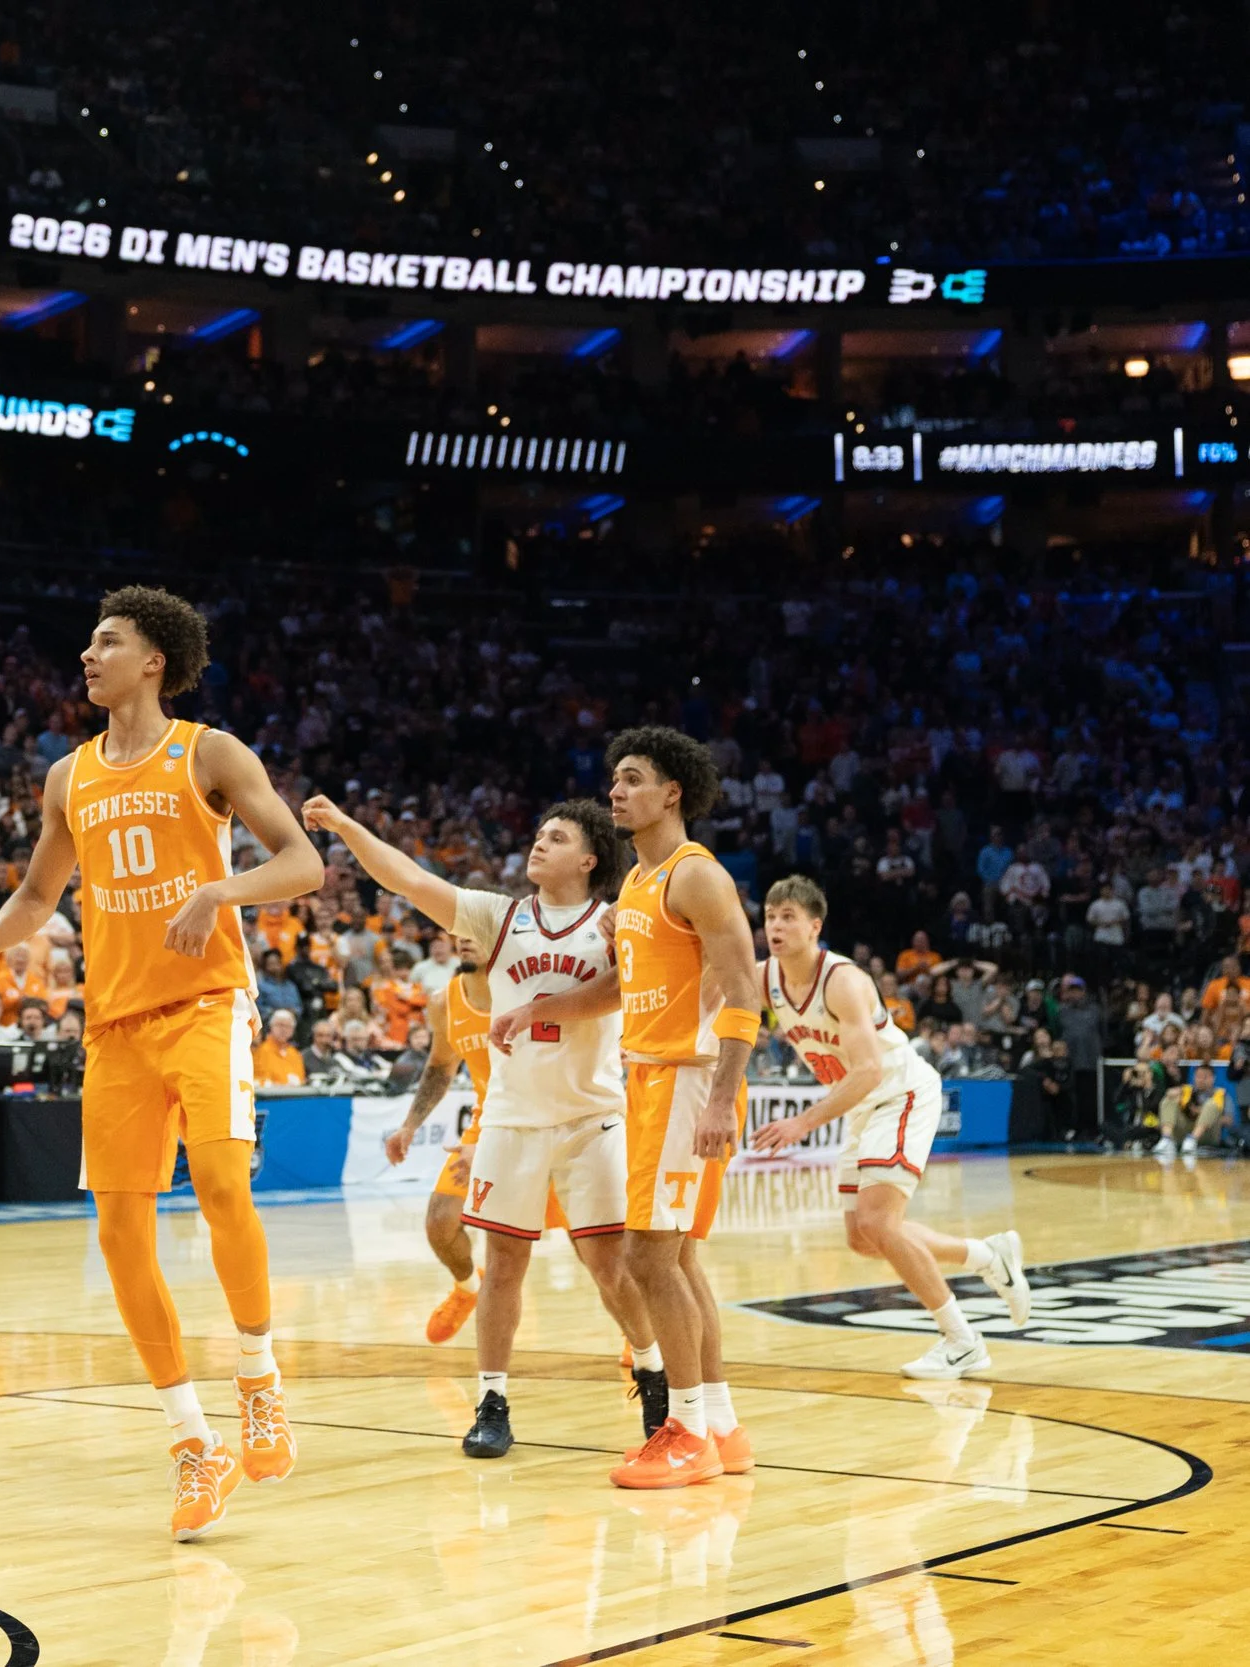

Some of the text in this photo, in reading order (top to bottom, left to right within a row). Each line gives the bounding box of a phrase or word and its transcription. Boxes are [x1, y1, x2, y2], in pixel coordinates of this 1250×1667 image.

[10, 214, 865, 302] 2026 DI MEN'S BASKETBALL CHAMPIONSHIP
[78, 792, 181, 832] TENNESSEE
[108, 825, 156, 879] 10
[91, 869, 198, 914] VOLUNTEERS
[507, 953, 597, 985] VIRGINIA
[472, 1177, 493, 1214] V
[665, 1172, 698, 1209] T
